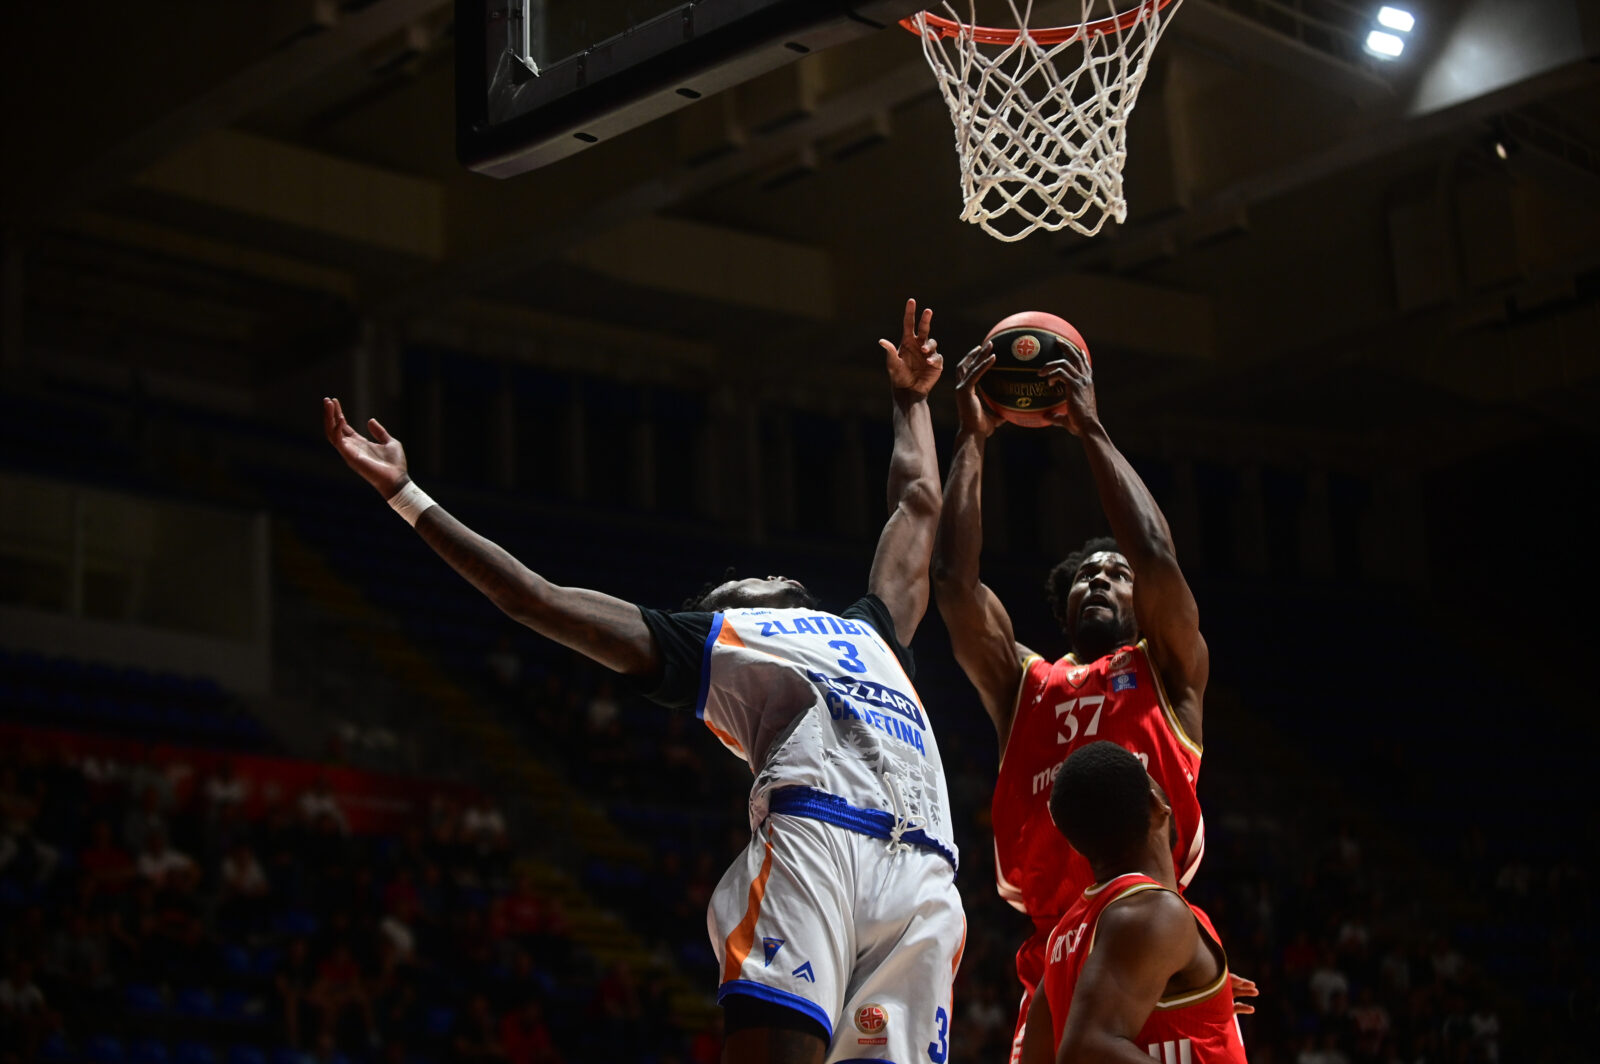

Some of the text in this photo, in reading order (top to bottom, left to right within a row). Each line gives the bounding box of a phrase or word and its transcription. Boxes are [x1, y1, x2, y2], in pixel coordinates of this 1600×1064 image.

[755, 616, 885, 651] ZLATIB
[828, 640, 867, 673] 3
[1055, 695, 1105, 745] 37
[927, 1006, 948, 1064] 3
